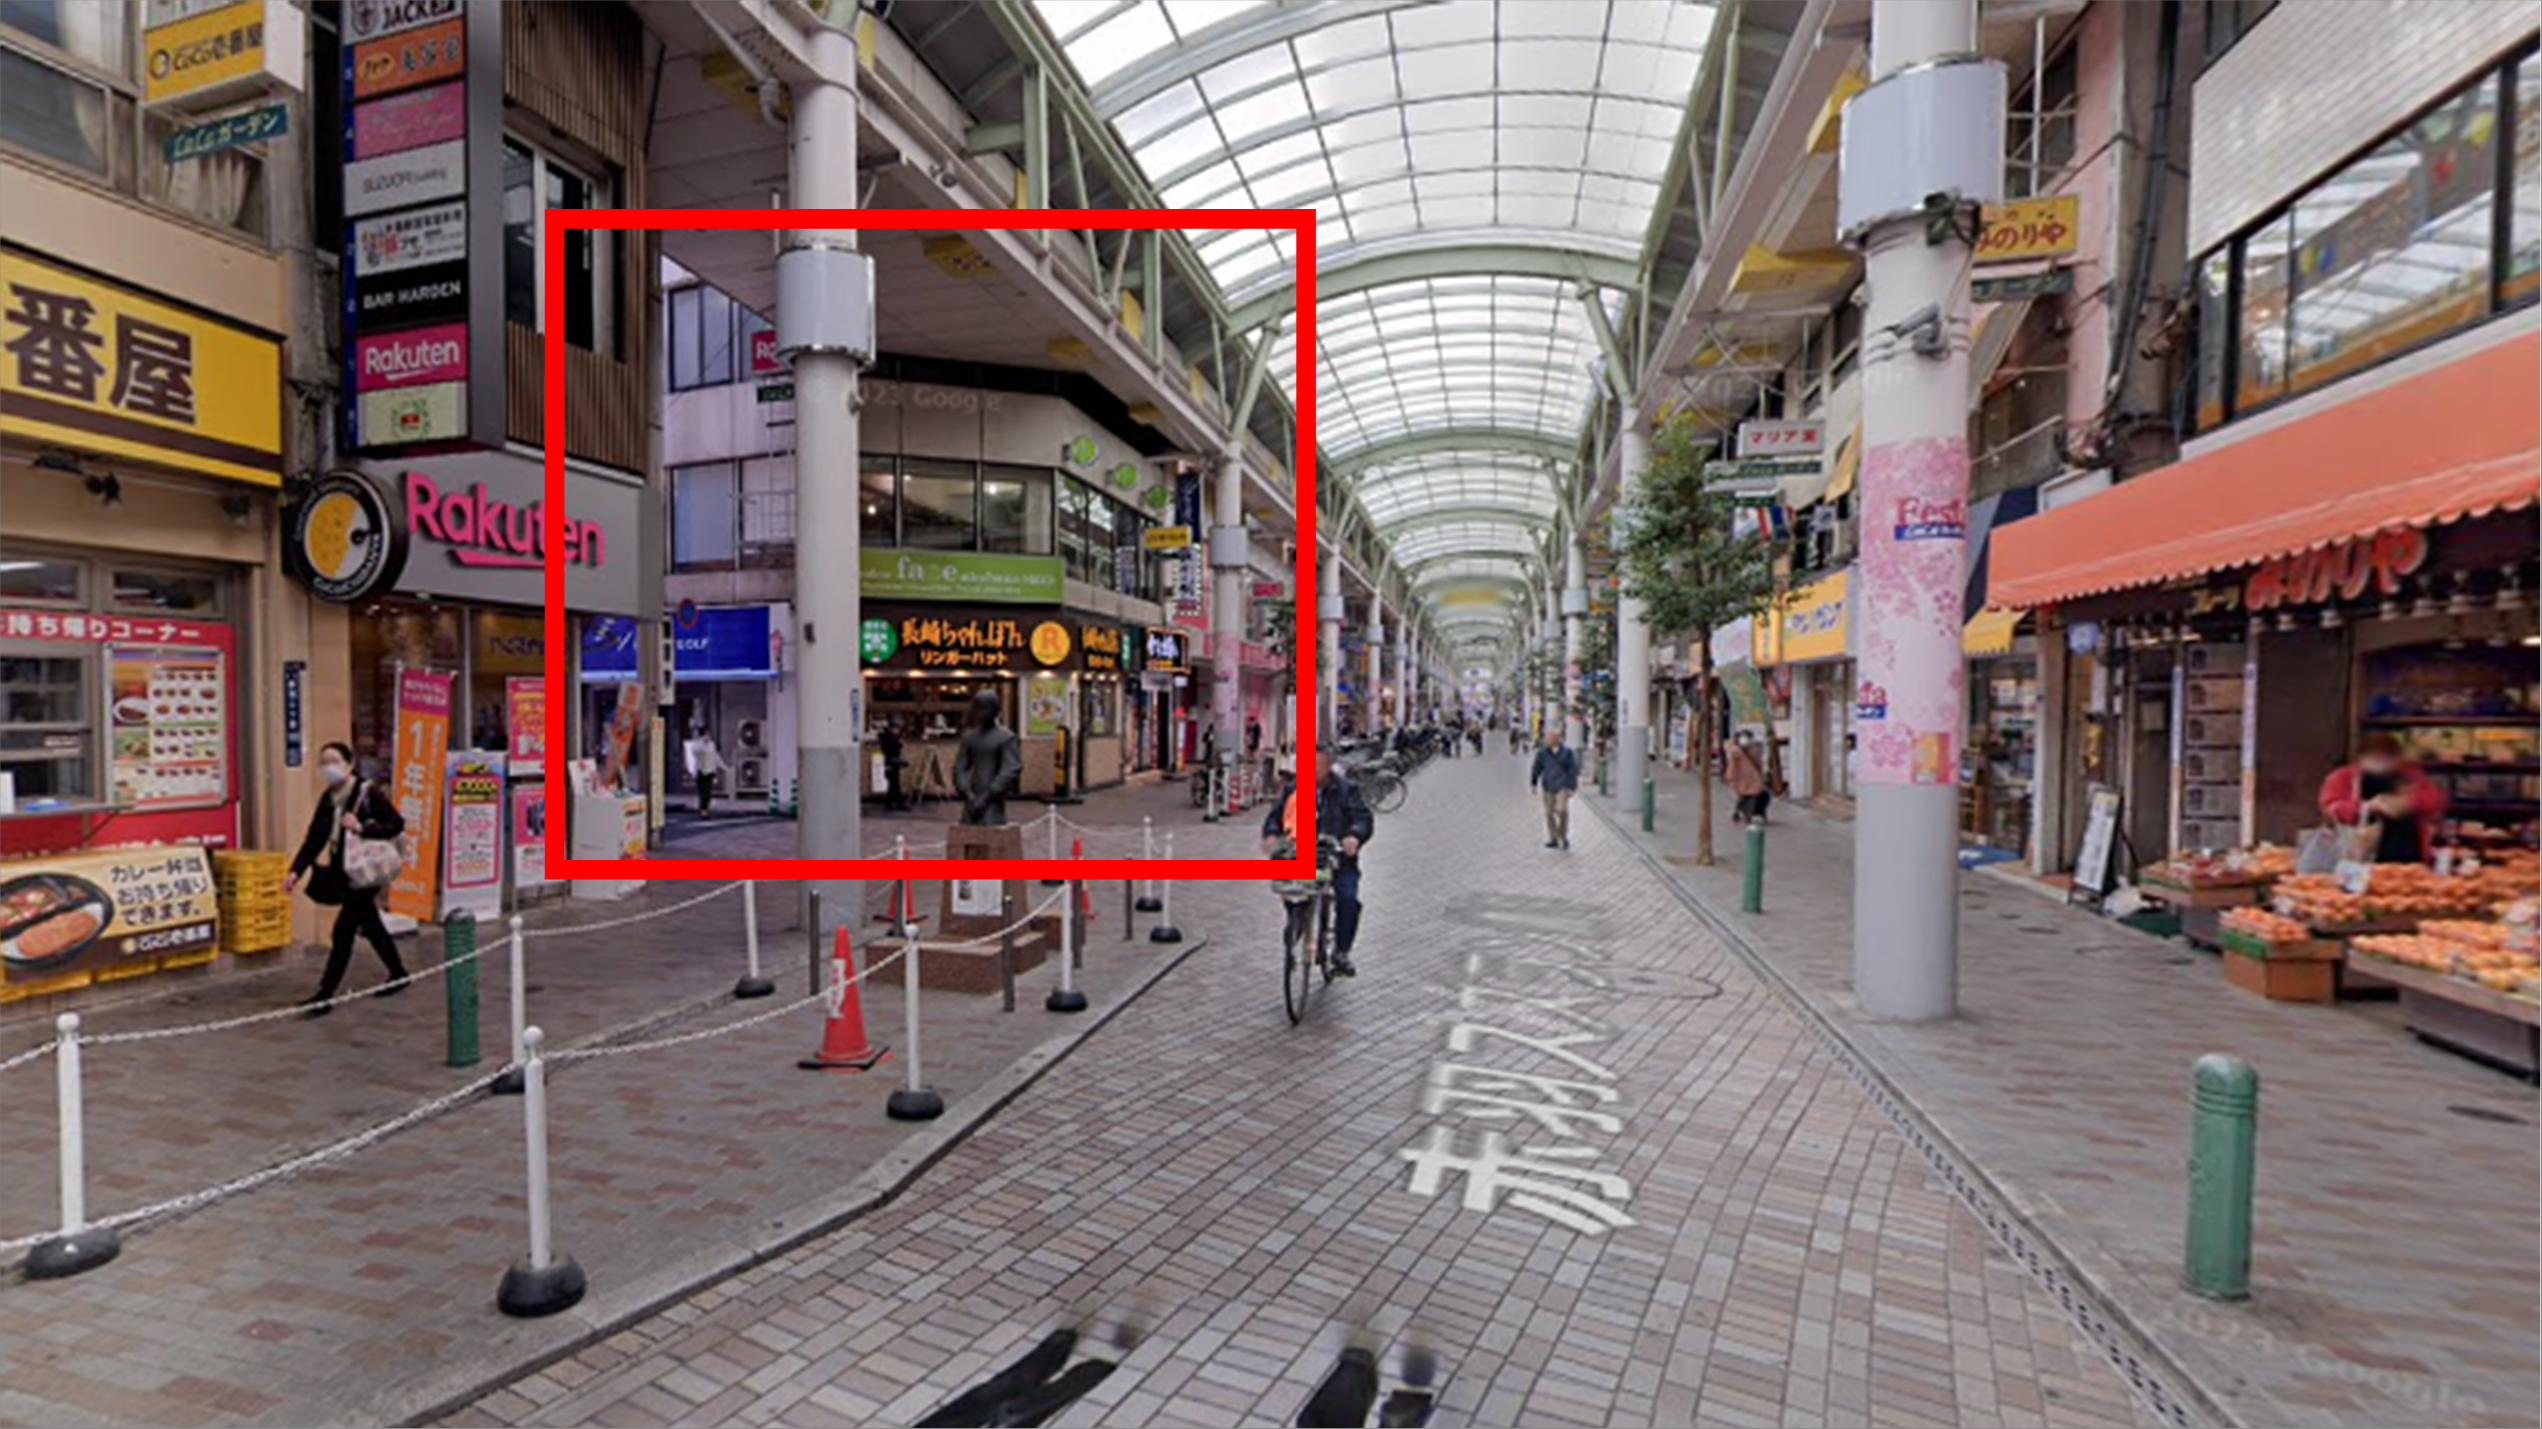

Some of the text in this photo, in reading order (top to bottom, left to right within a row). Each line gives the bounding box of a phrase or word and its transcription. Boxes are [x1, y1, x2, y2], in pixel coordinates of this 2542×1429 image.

[3, 283, 197, 426] 番屋
[364, 340, 460, 375] Rakuten
[902, 616, 1026, 648] 長崎ちゃんぽん
[1040, 625, 1062, 654] R
[920, 649, 1010, 666] リンガーハット
[110, 857, 205, 883] カレー弁当
[117, 876, 209, 906] お持ち帰り
